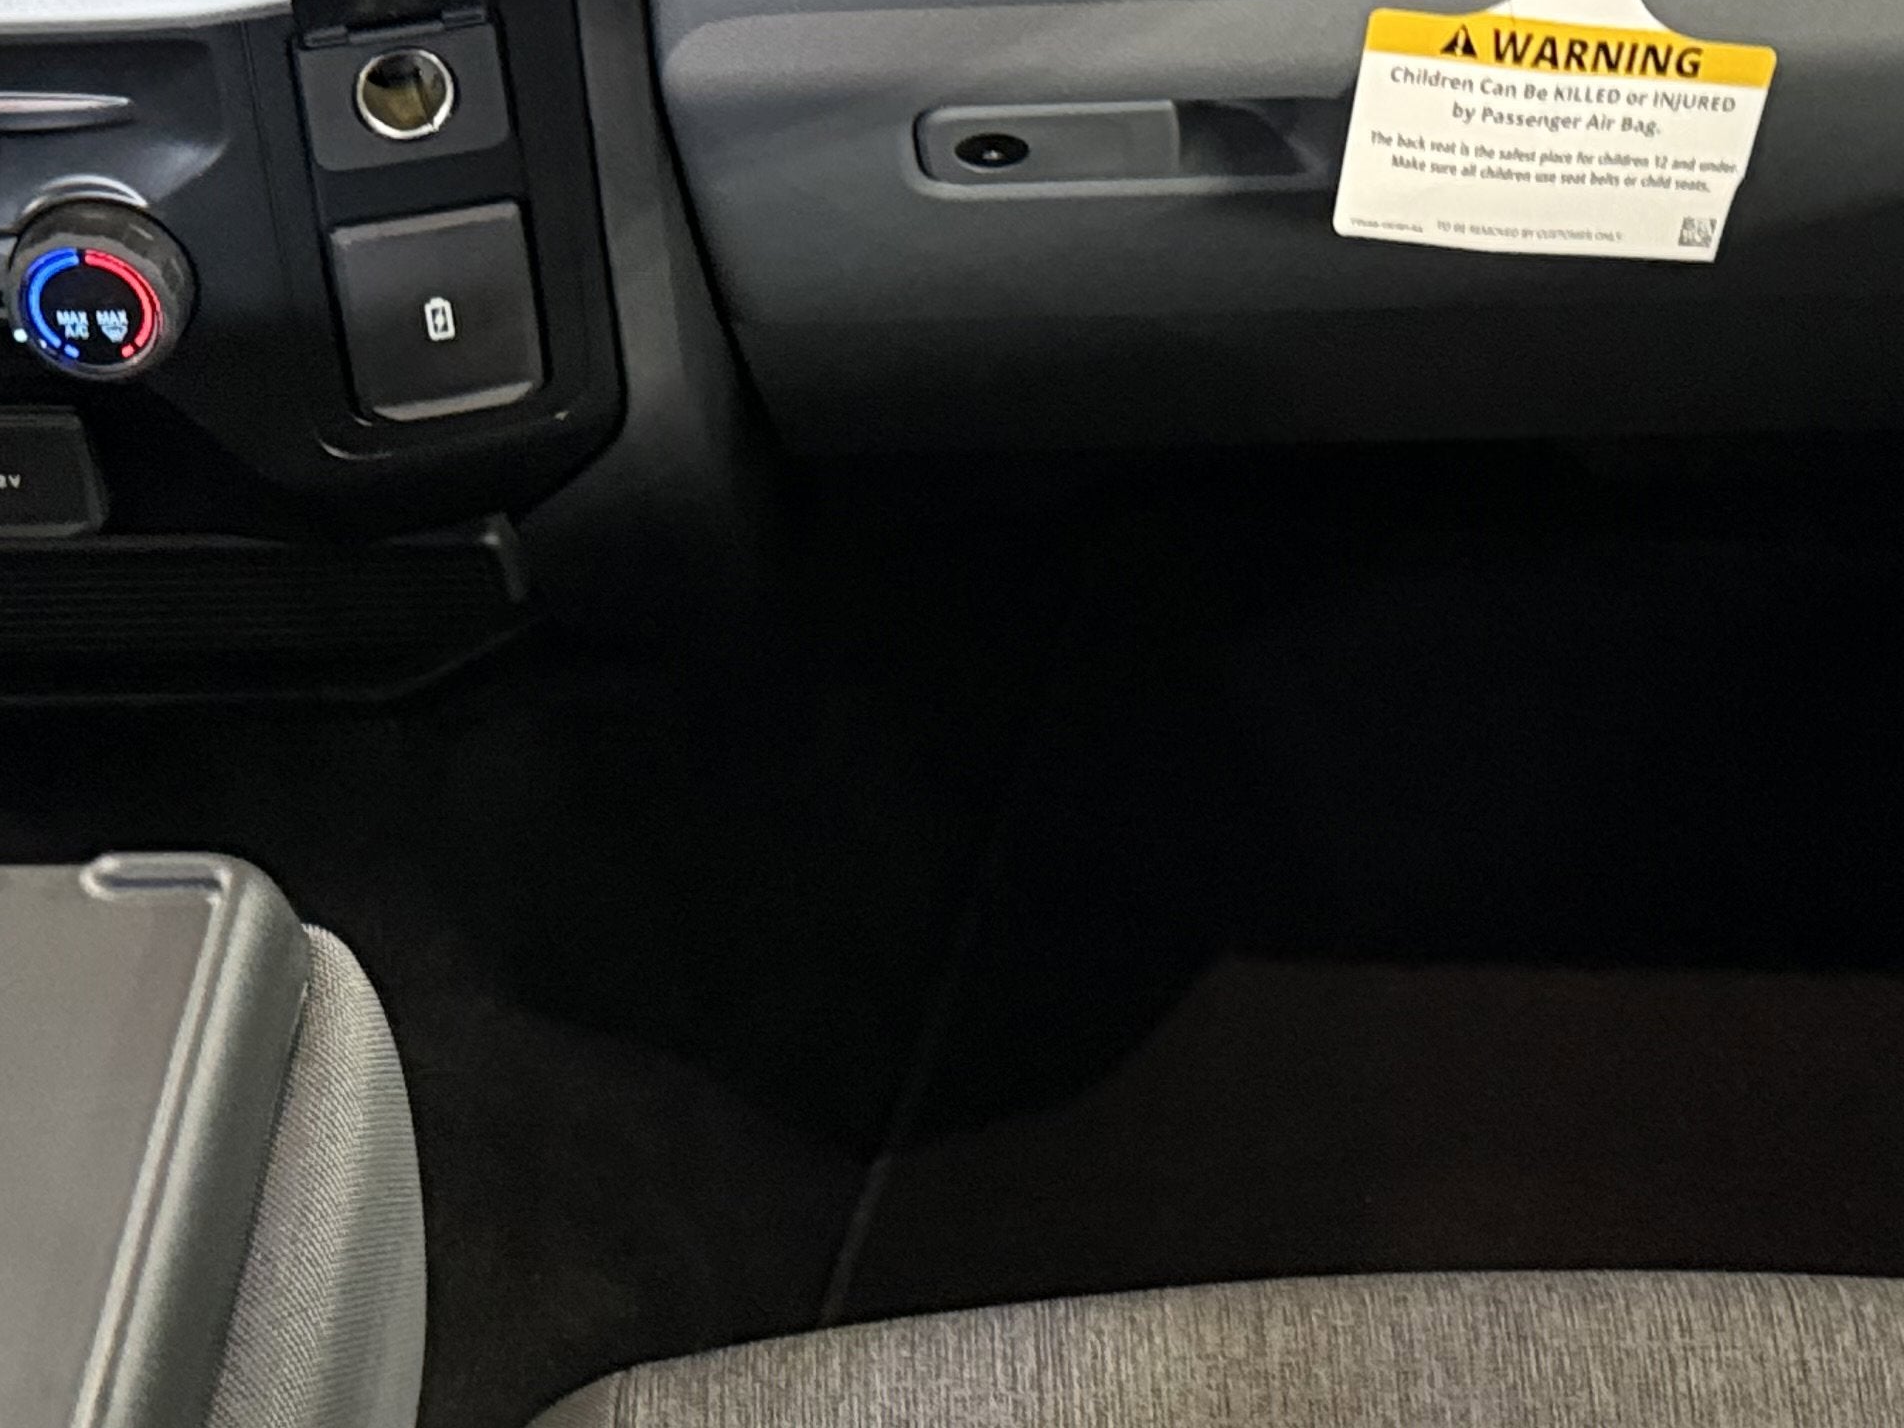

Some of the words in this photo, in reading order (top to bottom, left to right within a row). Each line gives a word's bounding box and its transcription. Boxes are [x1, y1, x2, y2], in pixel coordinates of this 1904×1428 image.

[1492, 27, 1703, 78] WARNING
[1390, 66, 1474, 92] Children
[1480, 77, 1517, 98] Can
[1524, 83, 1548, 102] Be
[1553, 88, 1622, 106] KILLED
[1626, 92, 1650, 107] or
[1653, 91, 1737, 112] INJURED
[1452, 102, 1475, 123] by
[1481, 108, 1582, 132] Passenger
[1586, 113, 1616, 130] Air
[1620, 117, 1663, 138] Bag.
[1371, 130, 1393, 147] The
[1397, 133, 1426, 151] back
[1430, 140, 1456, 156] seat
[1459, 139, 1470, 156] is
[1474, 142, 1496, 159] the
[1499, 144, 1537, 163] safest
[1539, 150, 1573, 167] place
[1576, 151, 1594, 166] for
[1597, 152, 1650, 168] children
[1654, 154, 1669, 169] 12
[1671, 157, 1697, 172] and
[1392, 155, 1426, 172] Make
[1430, 161, 1457, 175] sure
[1460, 162, 1477, 177] all
[1480, 165, 1532, 183] children
[1535, 172, 1557, 184] use
[1560, 172, 1586, 186] seat
[1590, 171, 1619, 188] belts
[1623, 174, 1638, 188] or
[1640, 174, 1671, 190] child
[56, 309, 89, 326] MAX
[96, 309, 129, 327] MAX
[7, 474, 21, 489] V
